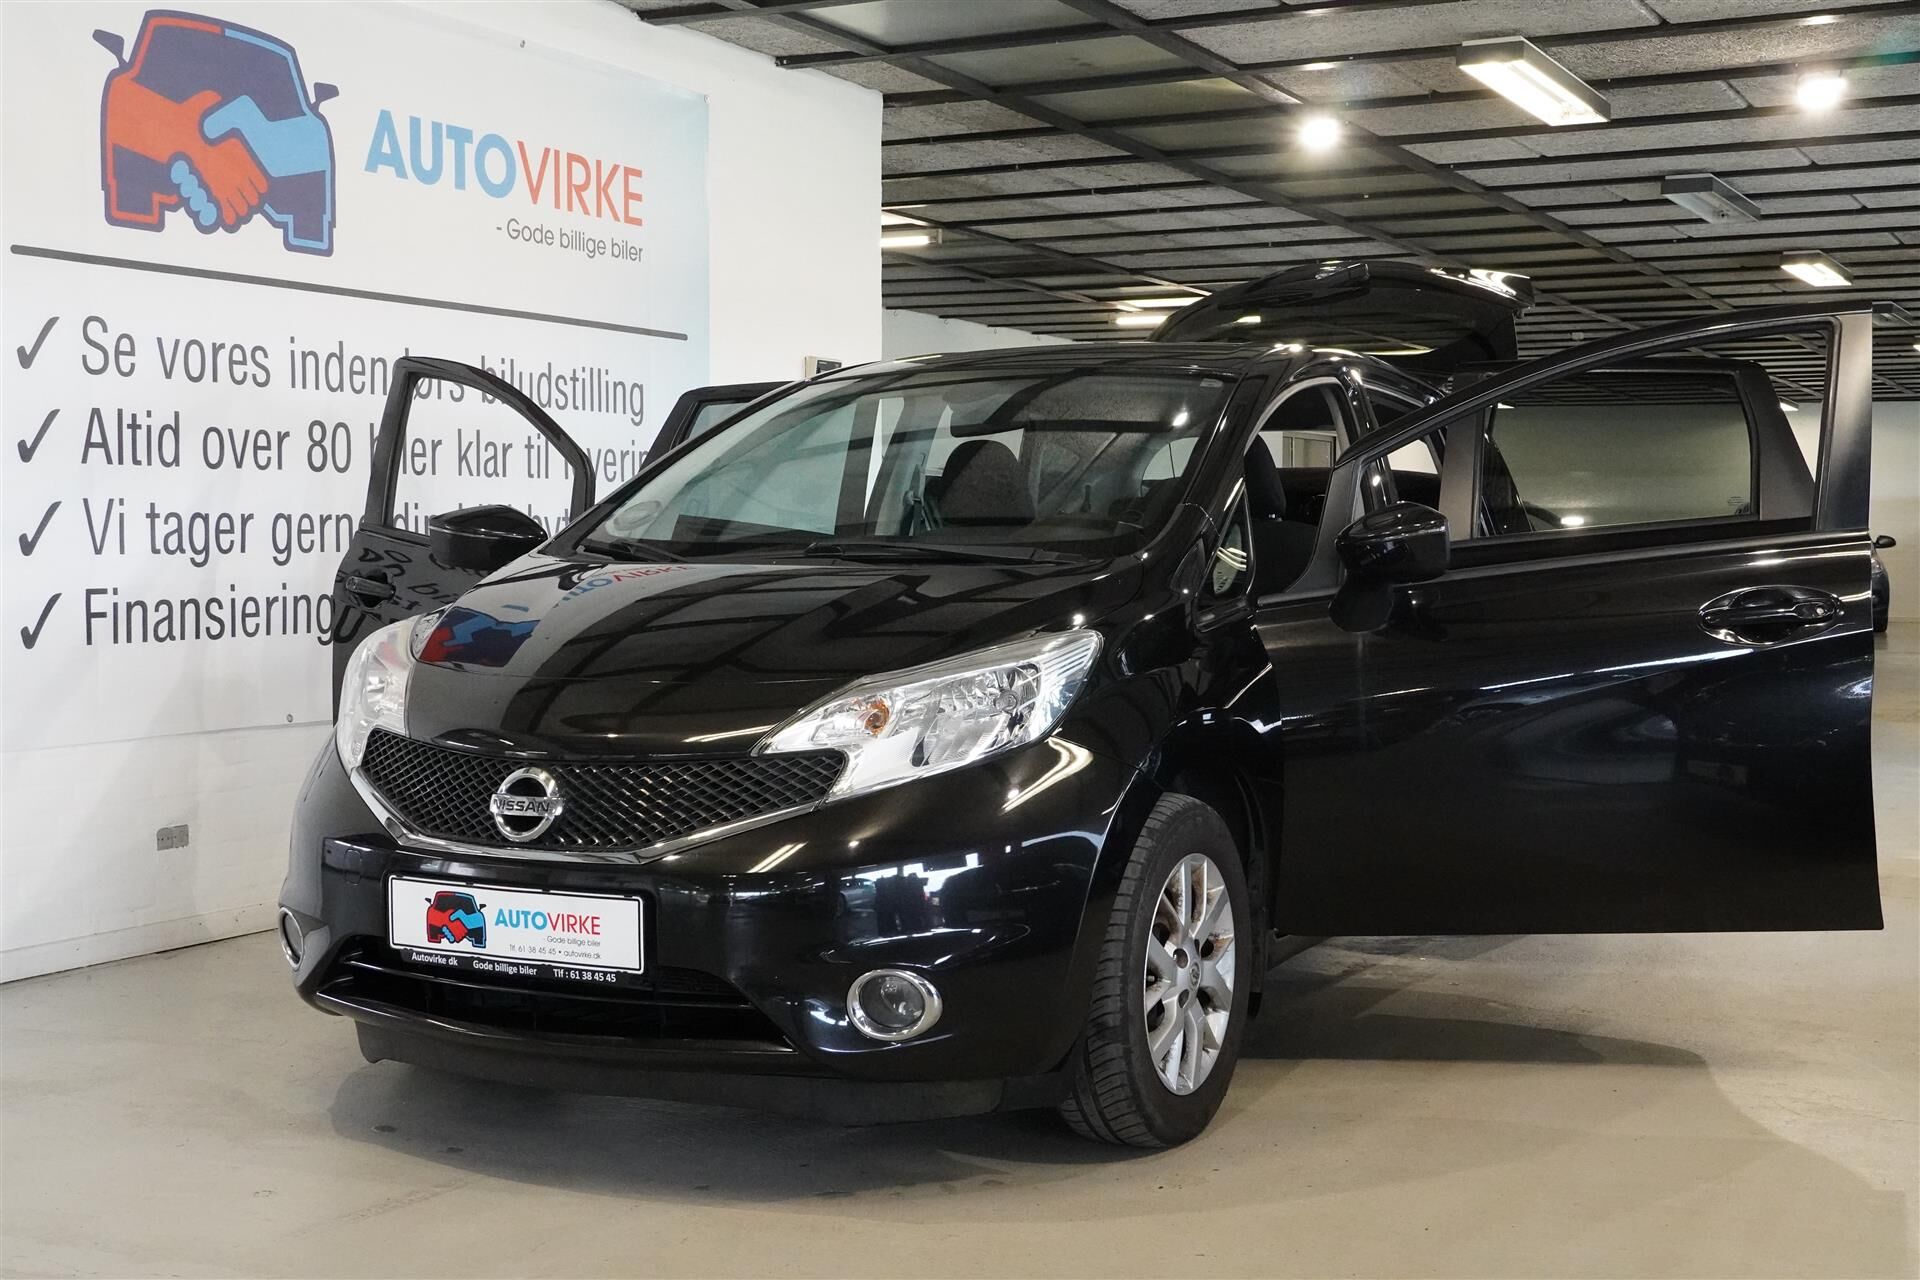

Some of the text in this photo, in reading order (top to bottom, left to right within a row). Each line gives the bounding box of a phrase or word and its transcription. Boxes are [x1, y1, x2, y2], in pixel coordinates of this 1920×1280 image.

[364, 109, 643, 226] AUTOVIRKE
[506, 217, 555, 246] Gode
[559, 228, 607, 259] billige
[611, 239, 643, 263] biler
[81, 315, 645, 427] Se vores indenørs biludstilling
[81, 407, 181, 469] Altid
[202, 426, 291, 471] over
[306, 420, 352, 474] 80
[457, 428, 514, 478] klar
[524, 433, 549, 479] til
[83, 497, 125, 555] Vi
[146, 502, 255, 568] tager
[272, 512, 365, 567] gern
[85, 582, 335, 646] Finansiering
[493, 798, 550, 812] NISSAN
[494, 908, 601, 935] AUTOVIRKE
[547, 935, 566, 945] Gode
[567, 938, 586, 948] billige
[411, 952, 447, 965] Autovirke
[473, 960, 493, 971] Gode
[494, 962, 518, 975] billige
[519, 964, 538, 976] biler
[553, 967, 565, 979] Tlf
[570, 970, 580, 980] 61
[582, 971, 593, 981] 38
[594, 972, 604, 982] 45
[606, 973, 617, 983] 45
[518, 944, 526, 953] 61
[528, 945, 537, 954] 38
[539, 946, 547, 955] 45
[548, 947, 557, 956] 45
